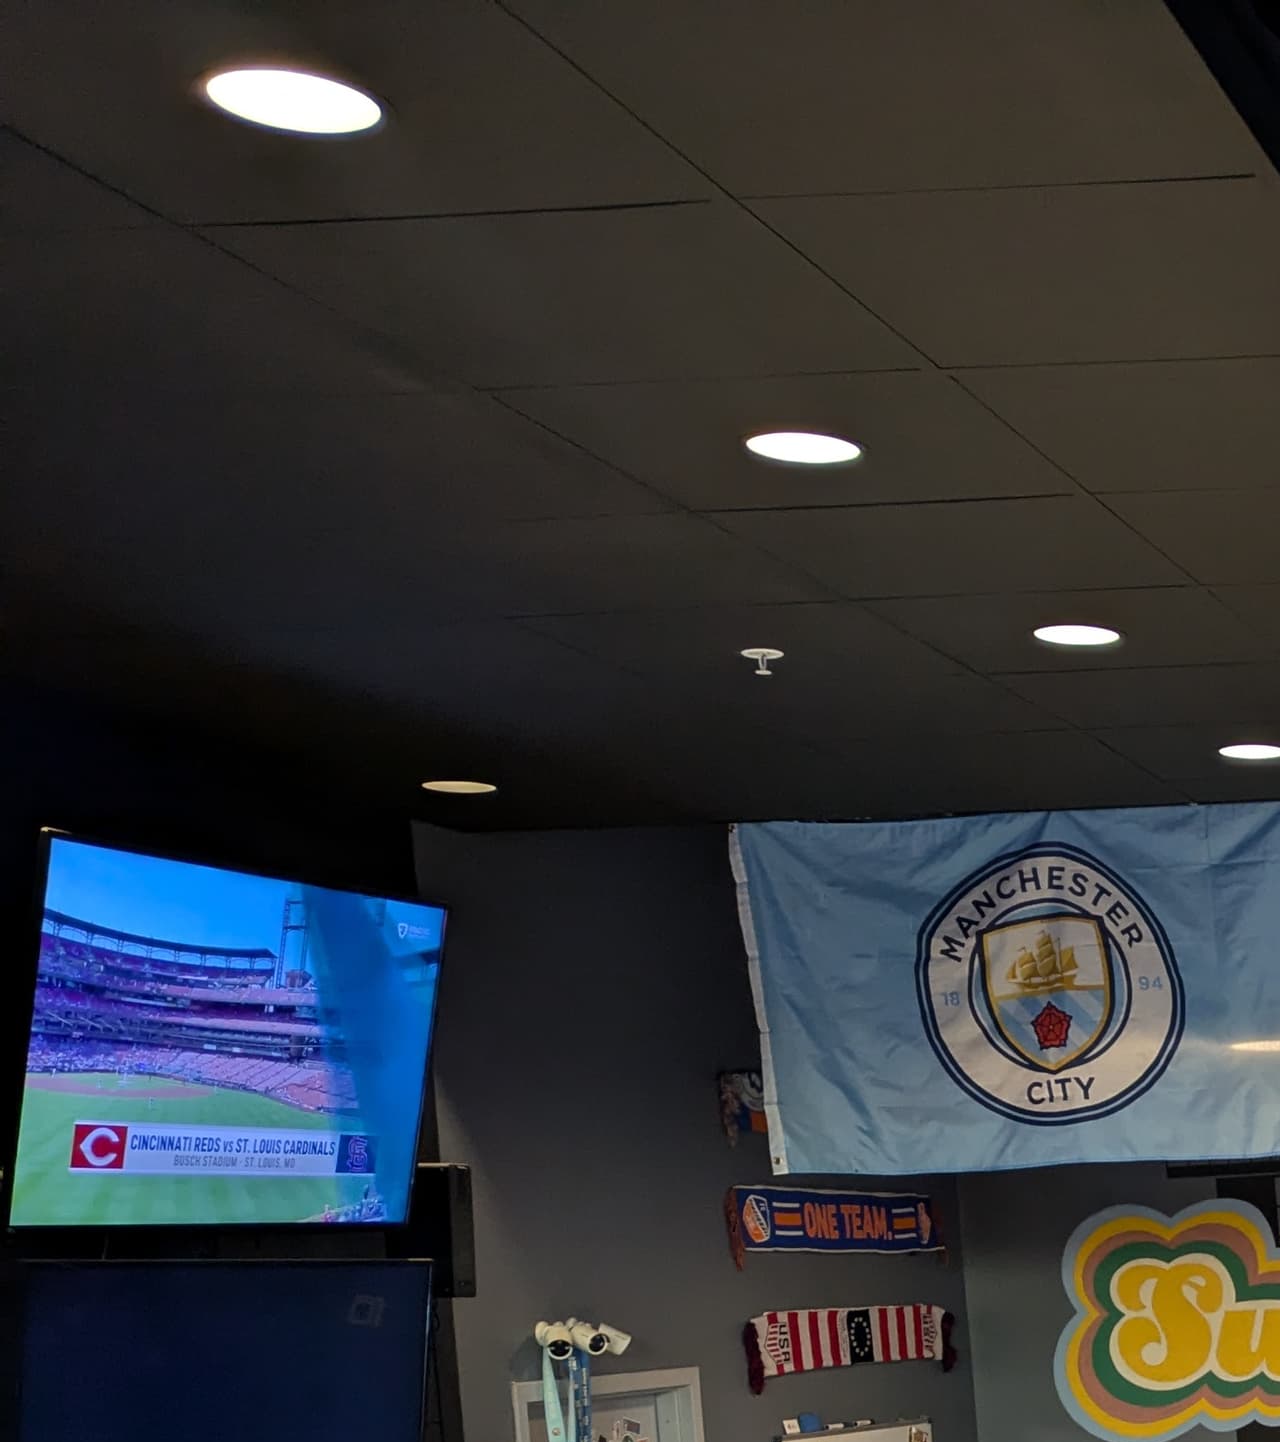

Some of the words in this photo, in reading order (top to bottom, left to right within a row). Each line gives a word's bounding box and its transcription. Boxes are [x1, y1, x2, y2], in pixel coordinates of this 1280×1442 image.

[940, 866, 1144, 963] MANCHESTER
[1138, 976, 1163, 991] 94
[941, 992, 961, 1007] 18
[1027, 1077, 1095, 1105] CITY
[131, 1134, 193, 1152] CINCINNATI
[194, 1137, 220, 1153] REDS
[223, 1141, 233, 1152] vs
[235, 1139, 251, 1154] ST.
[253, 1139, 281, 1154] LOUIS
[283, 1140, 335, 1156] CARDINALS
[202, 1156, 237, 1167] STADIUM
[804, 1202, 839, 1239] ONE
[841, 1204, 893, 1241] TEAM.
[776, 1322, 792, 1363] USA
